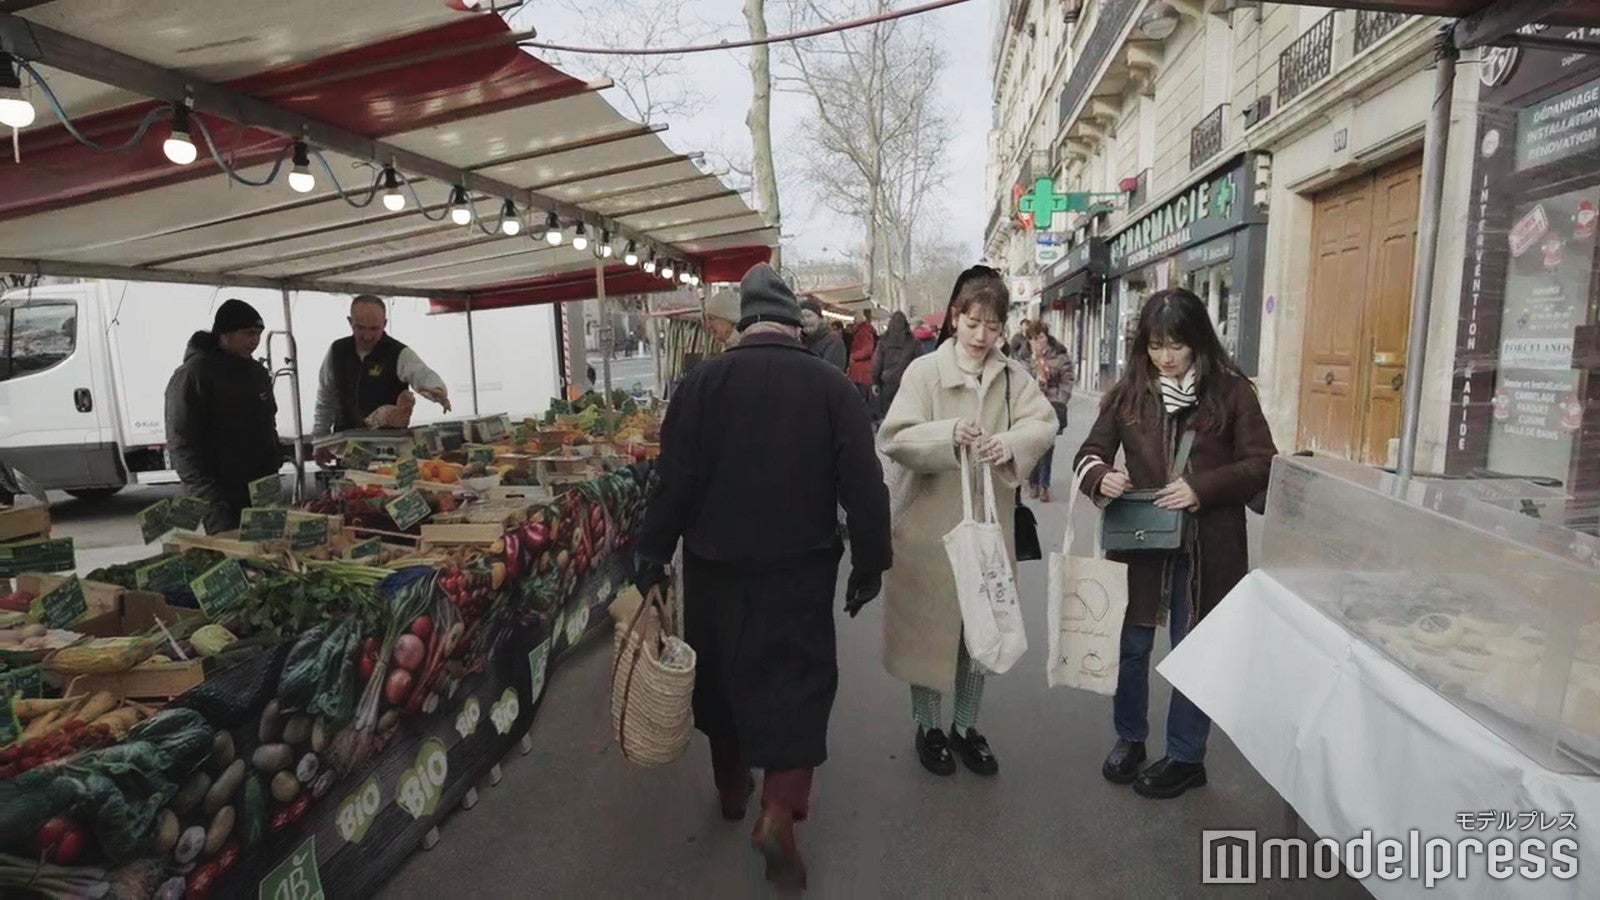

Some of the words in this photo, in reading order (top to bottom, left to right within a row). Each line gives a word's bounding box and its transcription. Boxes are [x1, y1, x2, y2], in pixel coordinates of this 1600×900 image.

[1119, 181, 1210, 258] PHARMACIE
[1466, 174, 1490, 350] INTERVENTION
[1458, 363, 1475, 451] RAPIDE
[456, 702, 480, 738] BIO
[490, 696, 519, 735] BIO
[337, 781, 381, 842] BIO
[400, 749, 448, 819] BIO
